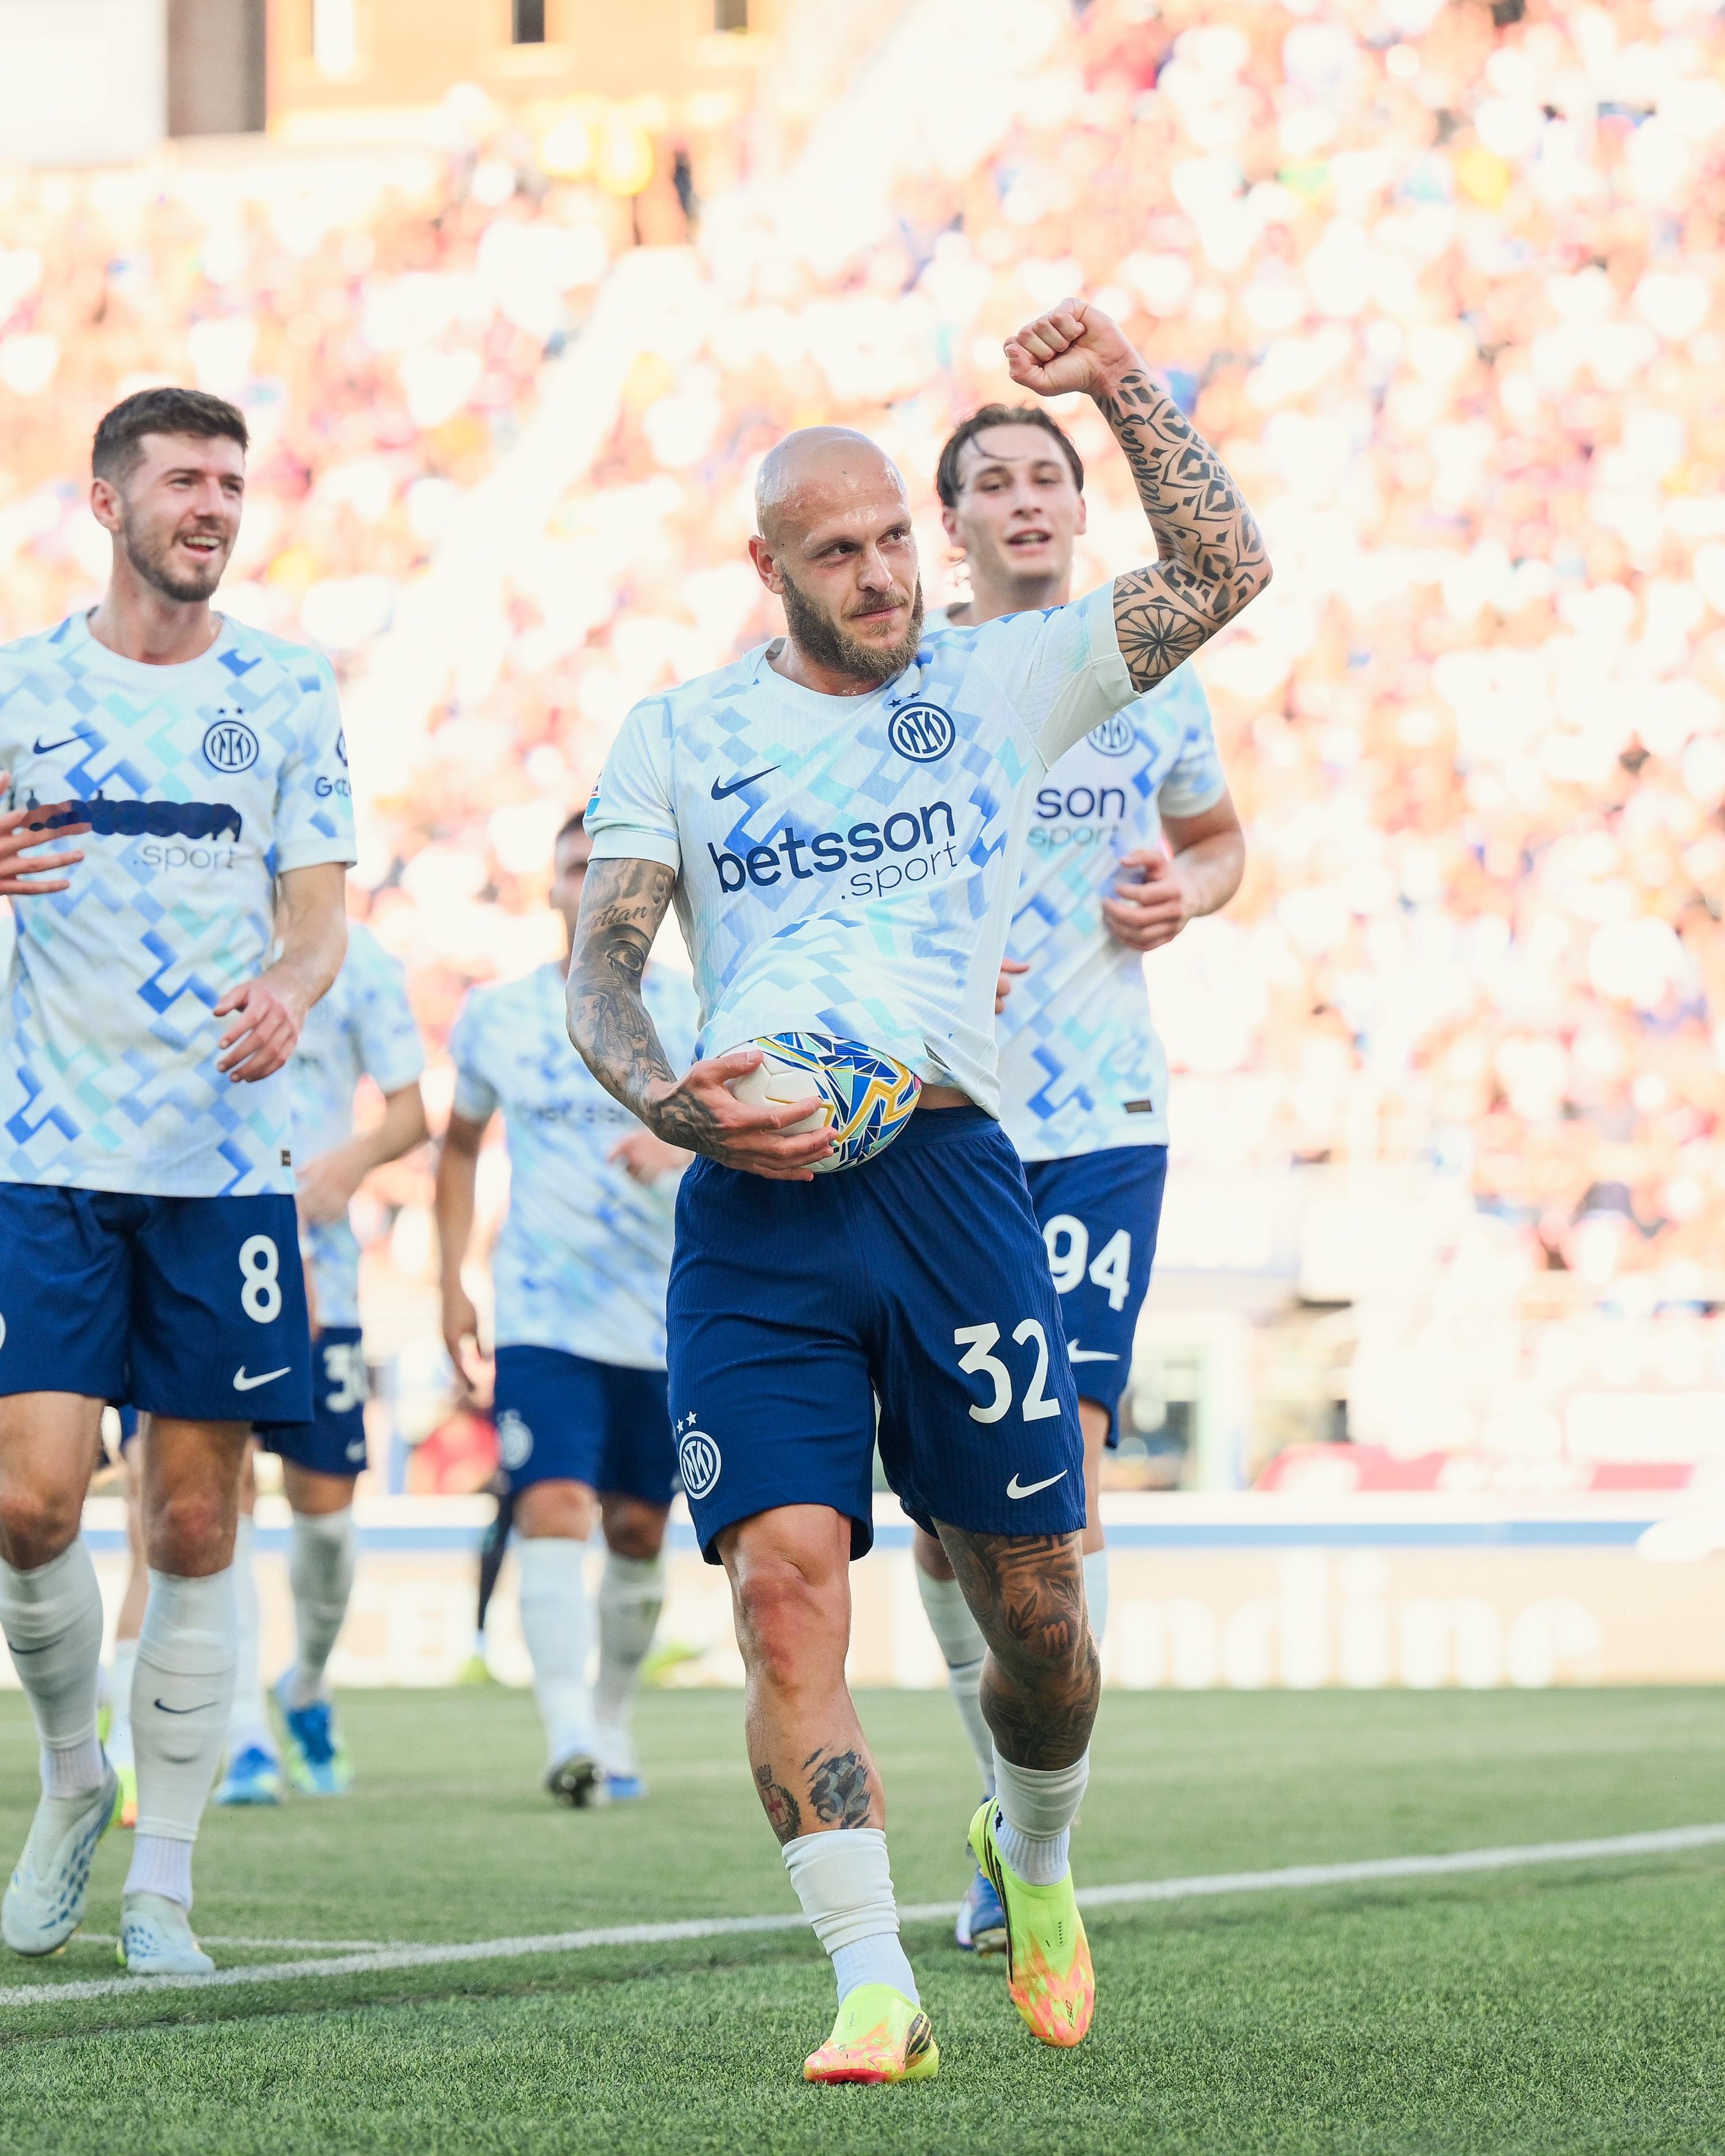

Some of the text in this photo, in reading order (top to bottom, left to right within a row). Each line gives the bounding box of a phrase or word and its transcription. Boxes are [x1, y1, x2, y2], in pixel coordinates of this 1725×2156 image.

[707, 801, 956, 893] betsson
[1037, 785, 1126, 819] son
[841, 841, 957, 900] .sport
[238, 1234, 282, 1324] 8
[1042, 1213, 1132, 1312] 94
[954, 1318, 1061, 1424] 32
[1107, 1547, 1605, 1691] ndine
